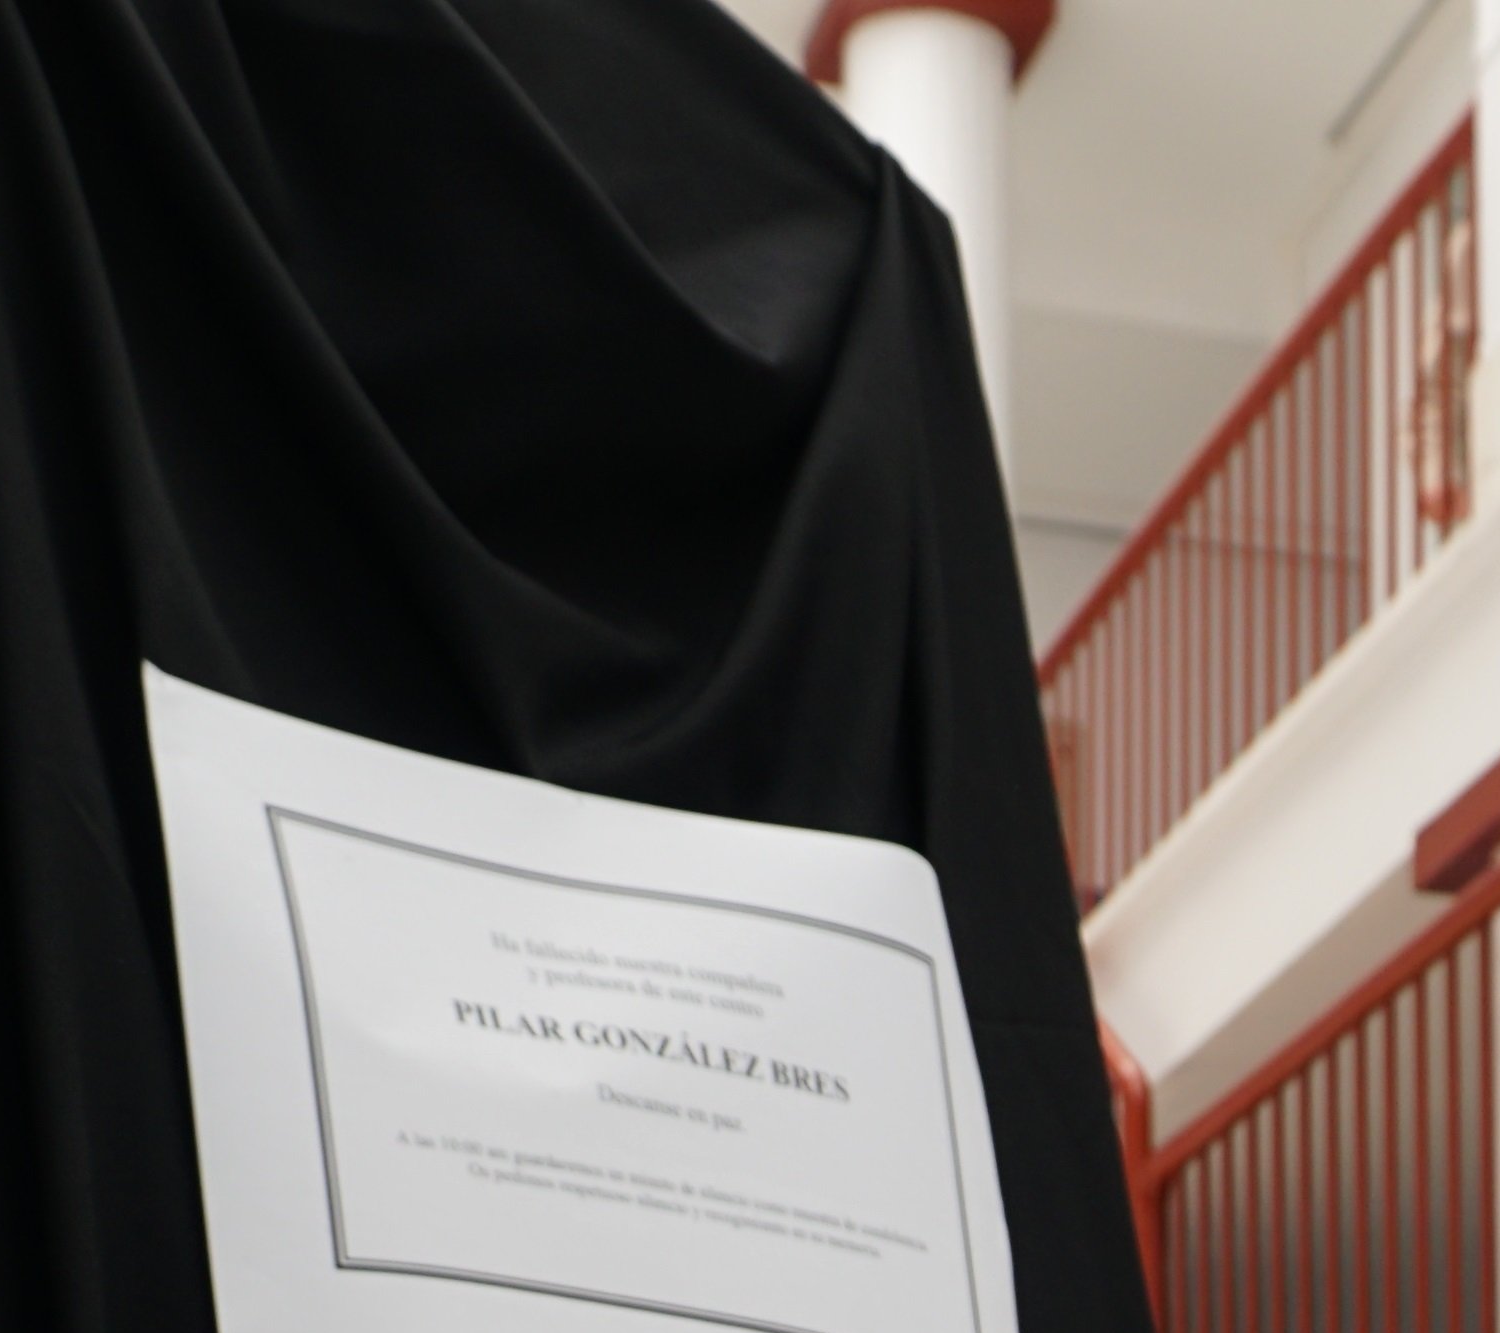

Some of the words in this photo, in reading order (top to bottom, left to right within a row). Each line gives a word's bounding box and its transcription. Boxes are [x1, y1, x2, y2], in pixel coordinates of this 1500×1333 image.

[454, 998, 566, 1044] PILAR
[573, 1018, 766, 1081] GONZÁLEZ
[770, 1058, 851, 1103] BRES
[597, 1081, 681, 1118] Descanse
